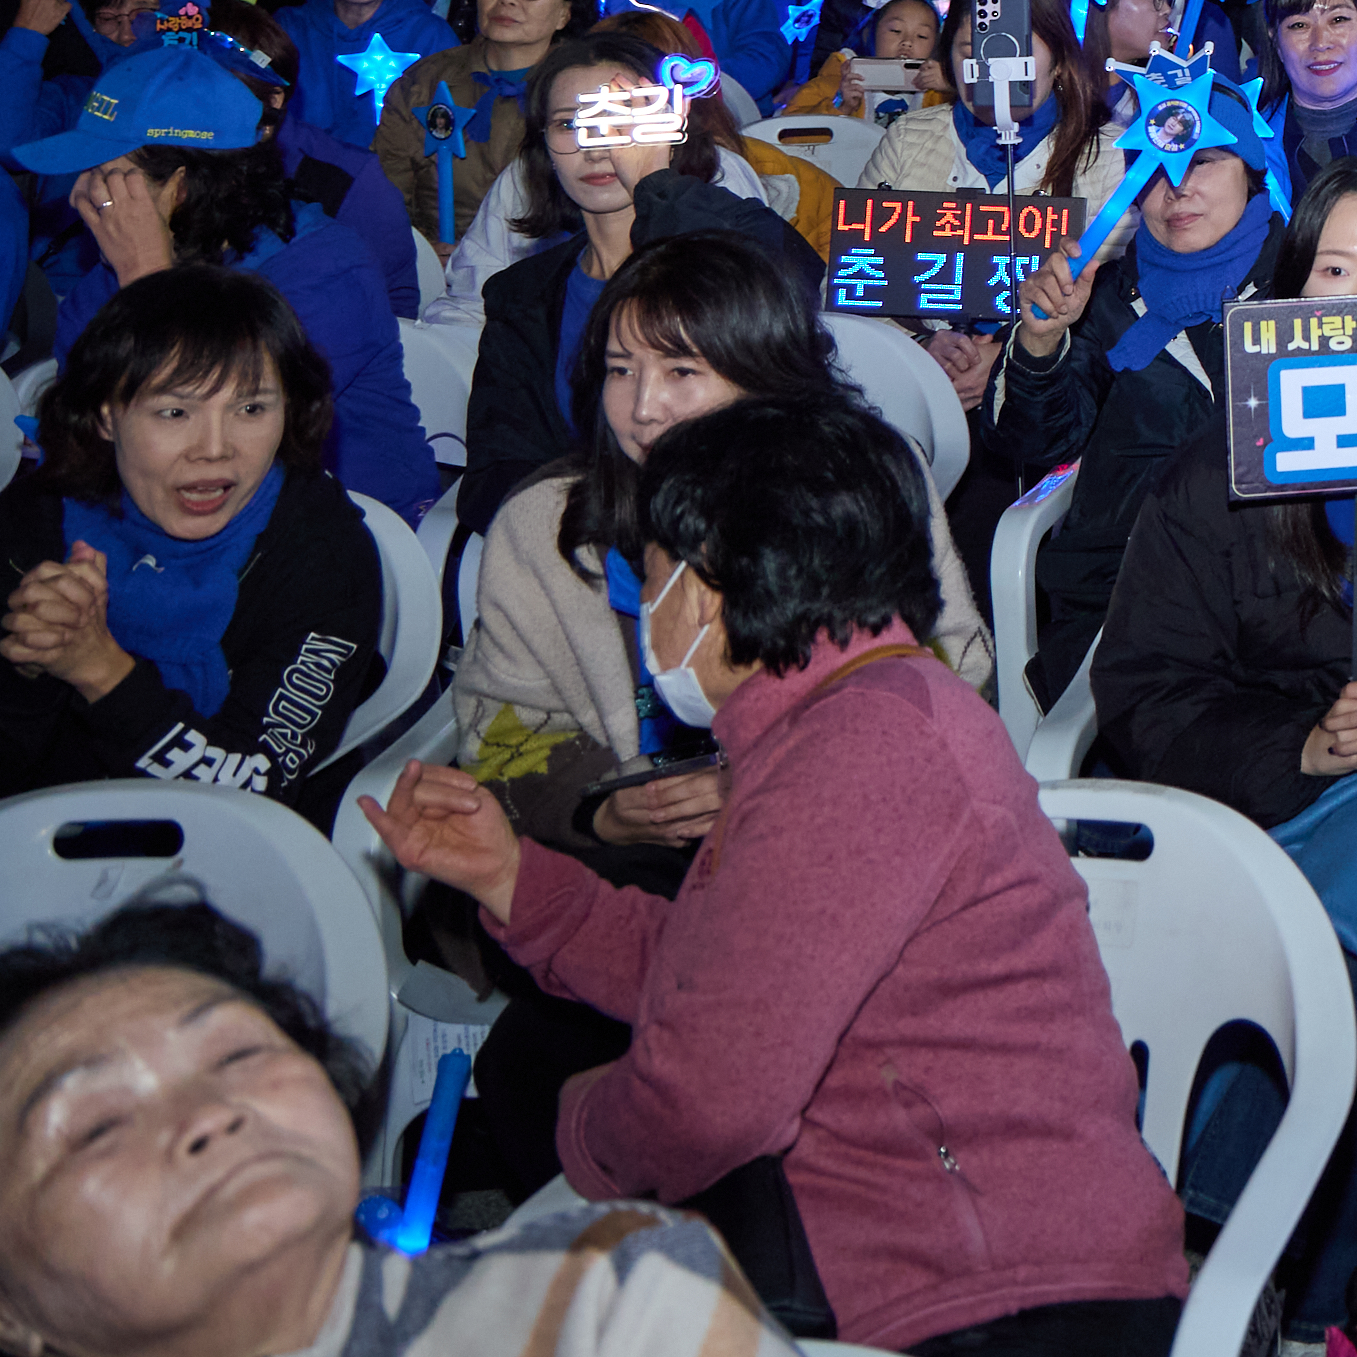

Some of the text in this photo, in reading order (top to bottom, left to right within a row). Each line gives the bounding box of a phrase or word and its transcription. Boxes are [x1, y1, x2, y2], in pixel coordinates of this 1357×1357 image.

[146, 126, 215, 141] springmose
[574, 83, 687, 148] 춘길
[838, 199, 1070, 250] 니가 최고야!
[1242, 319, 1277, 355] 내
